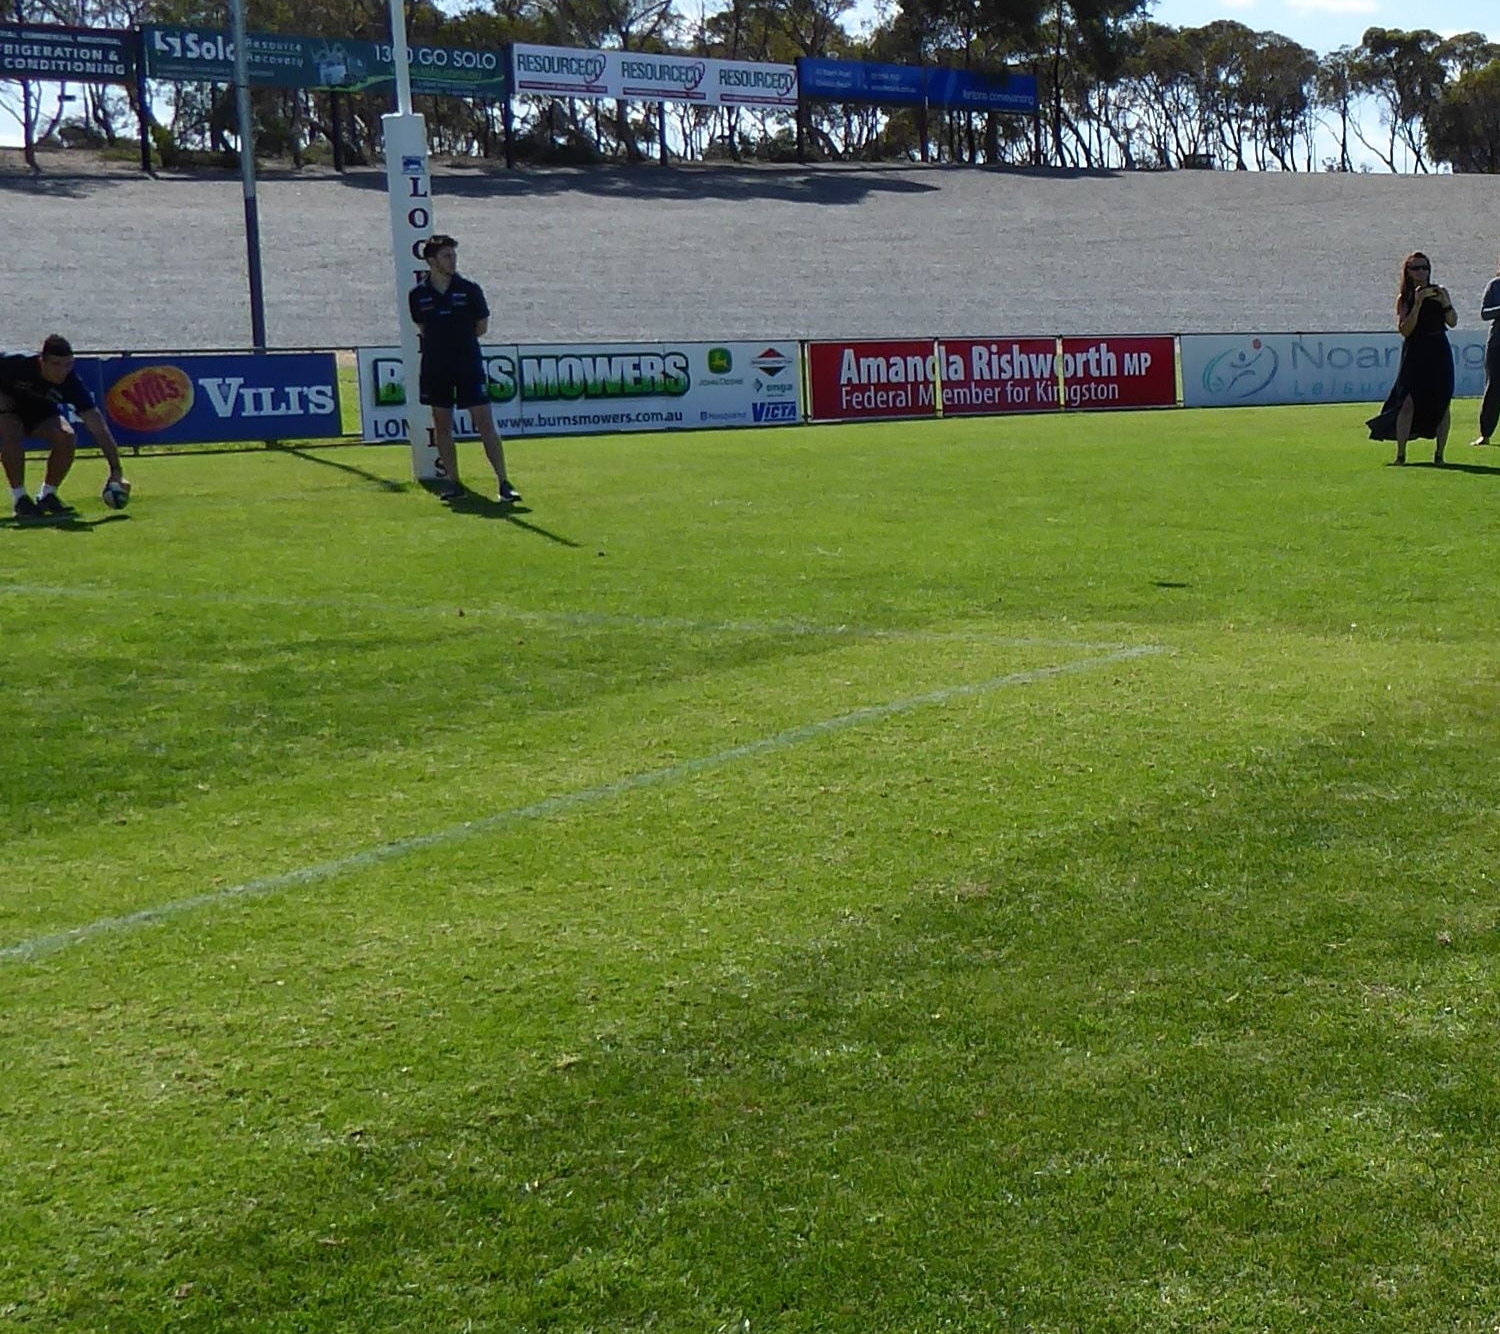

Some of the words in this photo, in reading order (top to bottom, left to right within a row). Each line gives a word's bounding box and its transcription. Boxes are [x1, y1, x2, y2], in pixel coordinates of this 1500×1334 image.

[0, 43, 103, 61] RIGERATION
[419, 48, 448, 66] GO
[453, 51, 496, 69] SOLO
[4, 57, 125, 75] CONDITIONING
[519, 352, 690, 400] MOWERS
[840, 344, 965, 385] Amanda
[972, 343, 1117, 381] Rishworth
[1124, 352, 1151, 376] MP
[841, 385, 911, 410] Federal
[919, 383, 1000, 407] Member
[1006, 383, 1030, 404] for
[1036, 381, 1119, 406] Kingston
